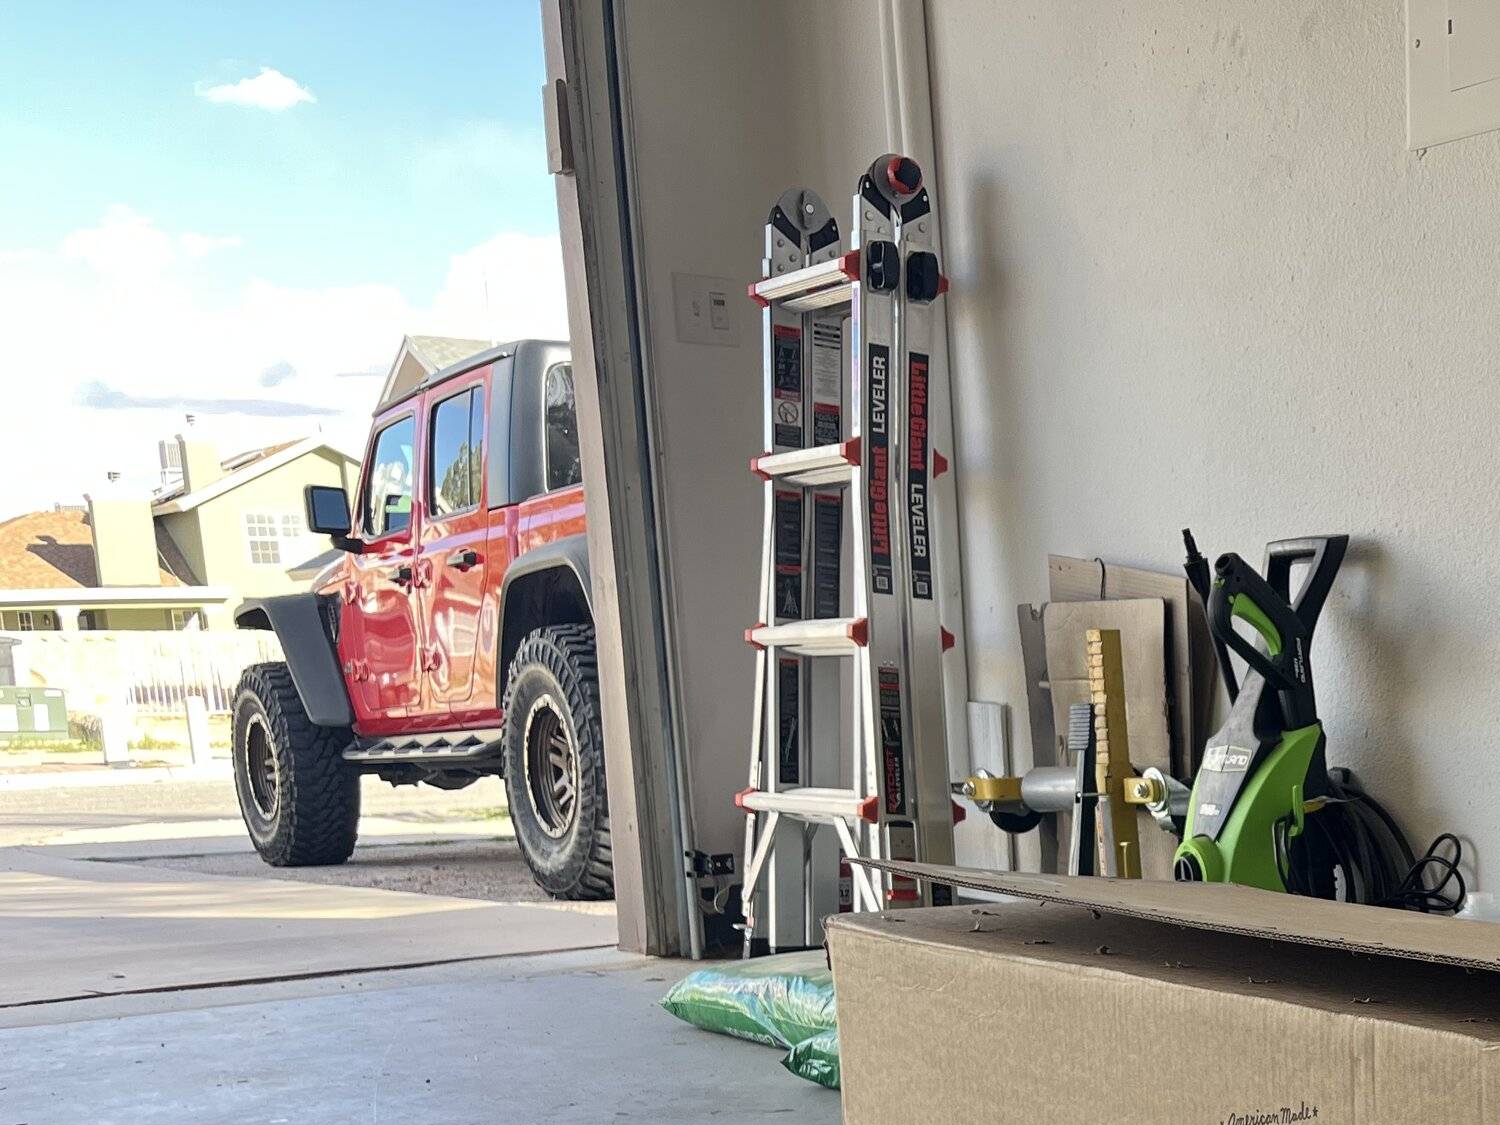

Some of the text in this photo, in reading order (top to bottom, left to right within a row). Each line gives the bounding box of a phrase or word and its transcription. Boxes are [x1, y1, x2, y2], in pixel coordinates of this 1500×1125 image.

[873, 355, 886, 434] LEVELER
[911, 483, 927, 557] LEVELER
[1280, 1101, 1311, 1124] Made
